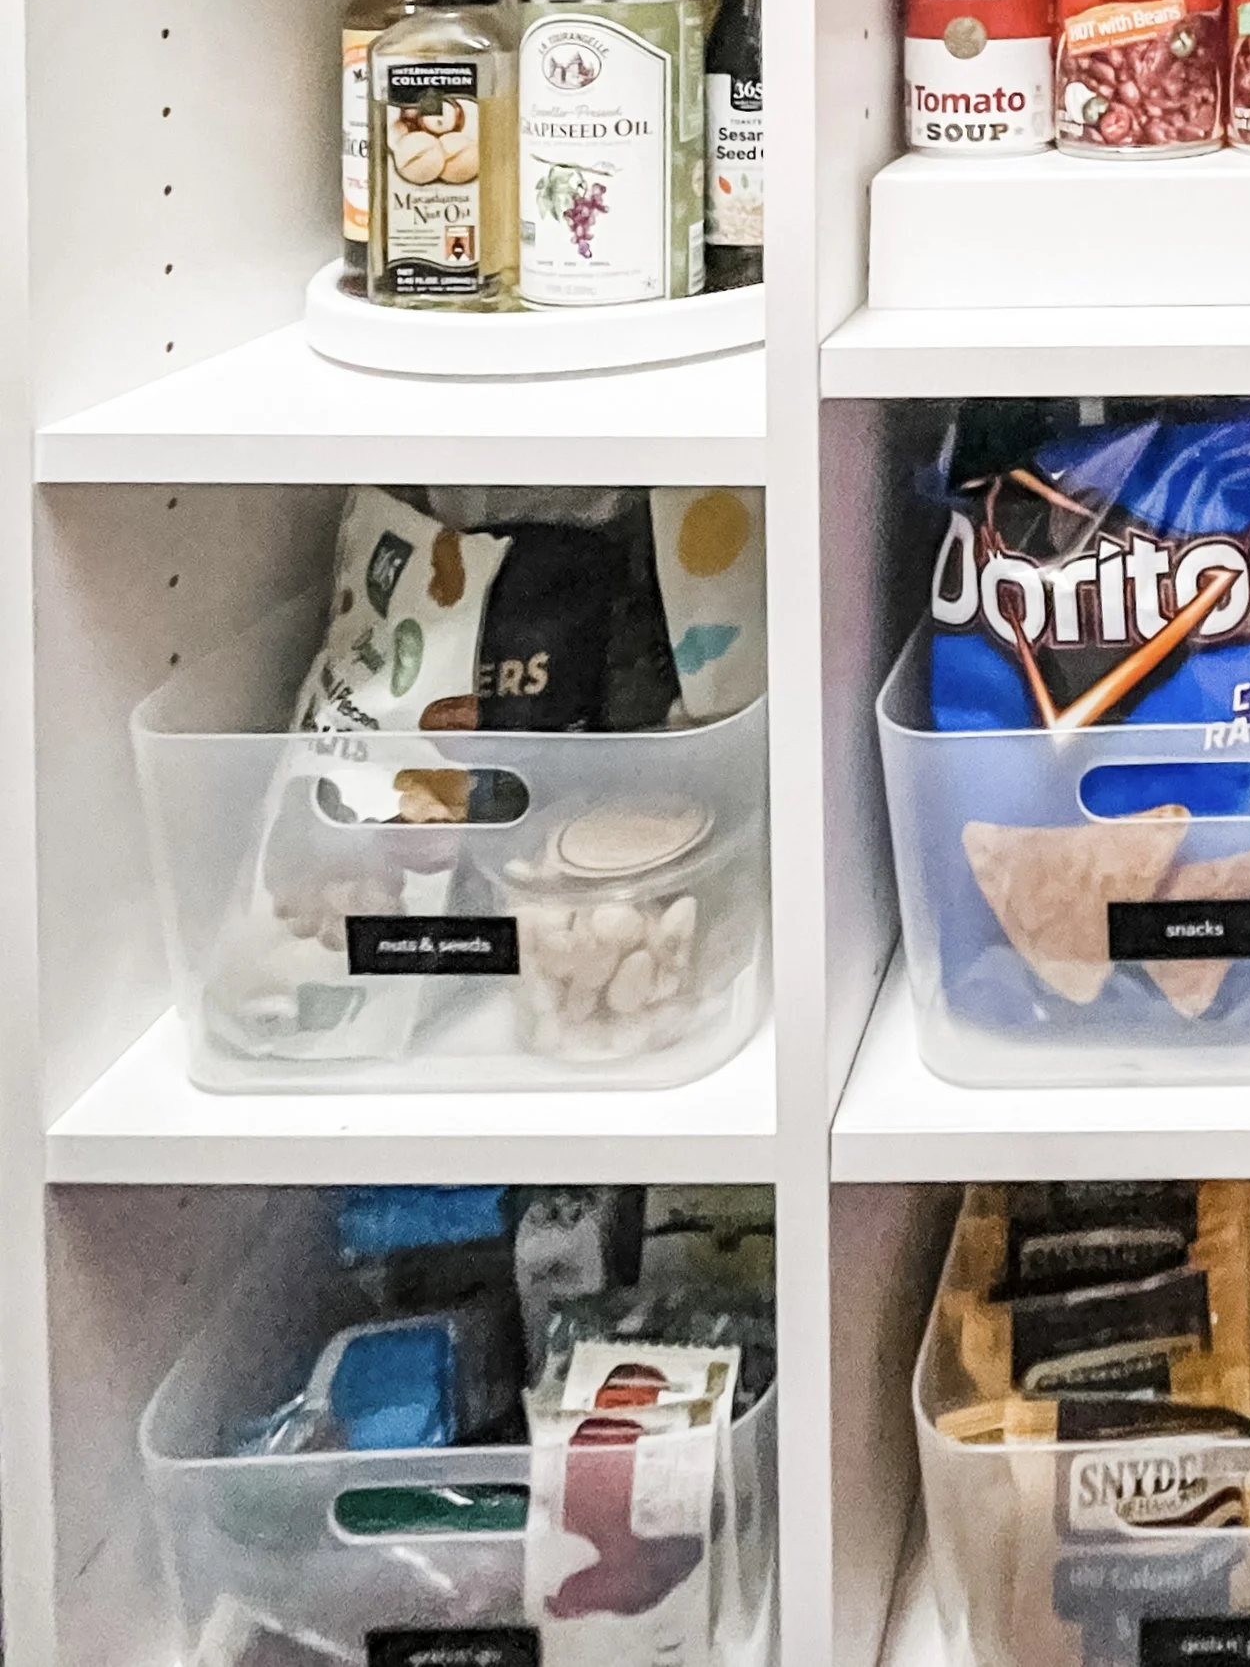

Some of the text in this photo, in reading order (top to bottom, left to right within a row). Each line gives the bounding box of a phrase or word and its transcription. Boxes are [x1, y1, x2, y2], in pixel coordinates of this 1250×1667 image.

[1069, 4, 1181, 41] HOT with Beans
[391, 76, 473, 86] COLLECTION
[914, 84, 1026, 114] Tomato
[926, 122, 1009, 142] SOUP
[715, 145, 757, 161] Seed
[1165, 920, 1224, 938] snacks
[378, 936, 492, 954] nuts & seeds
